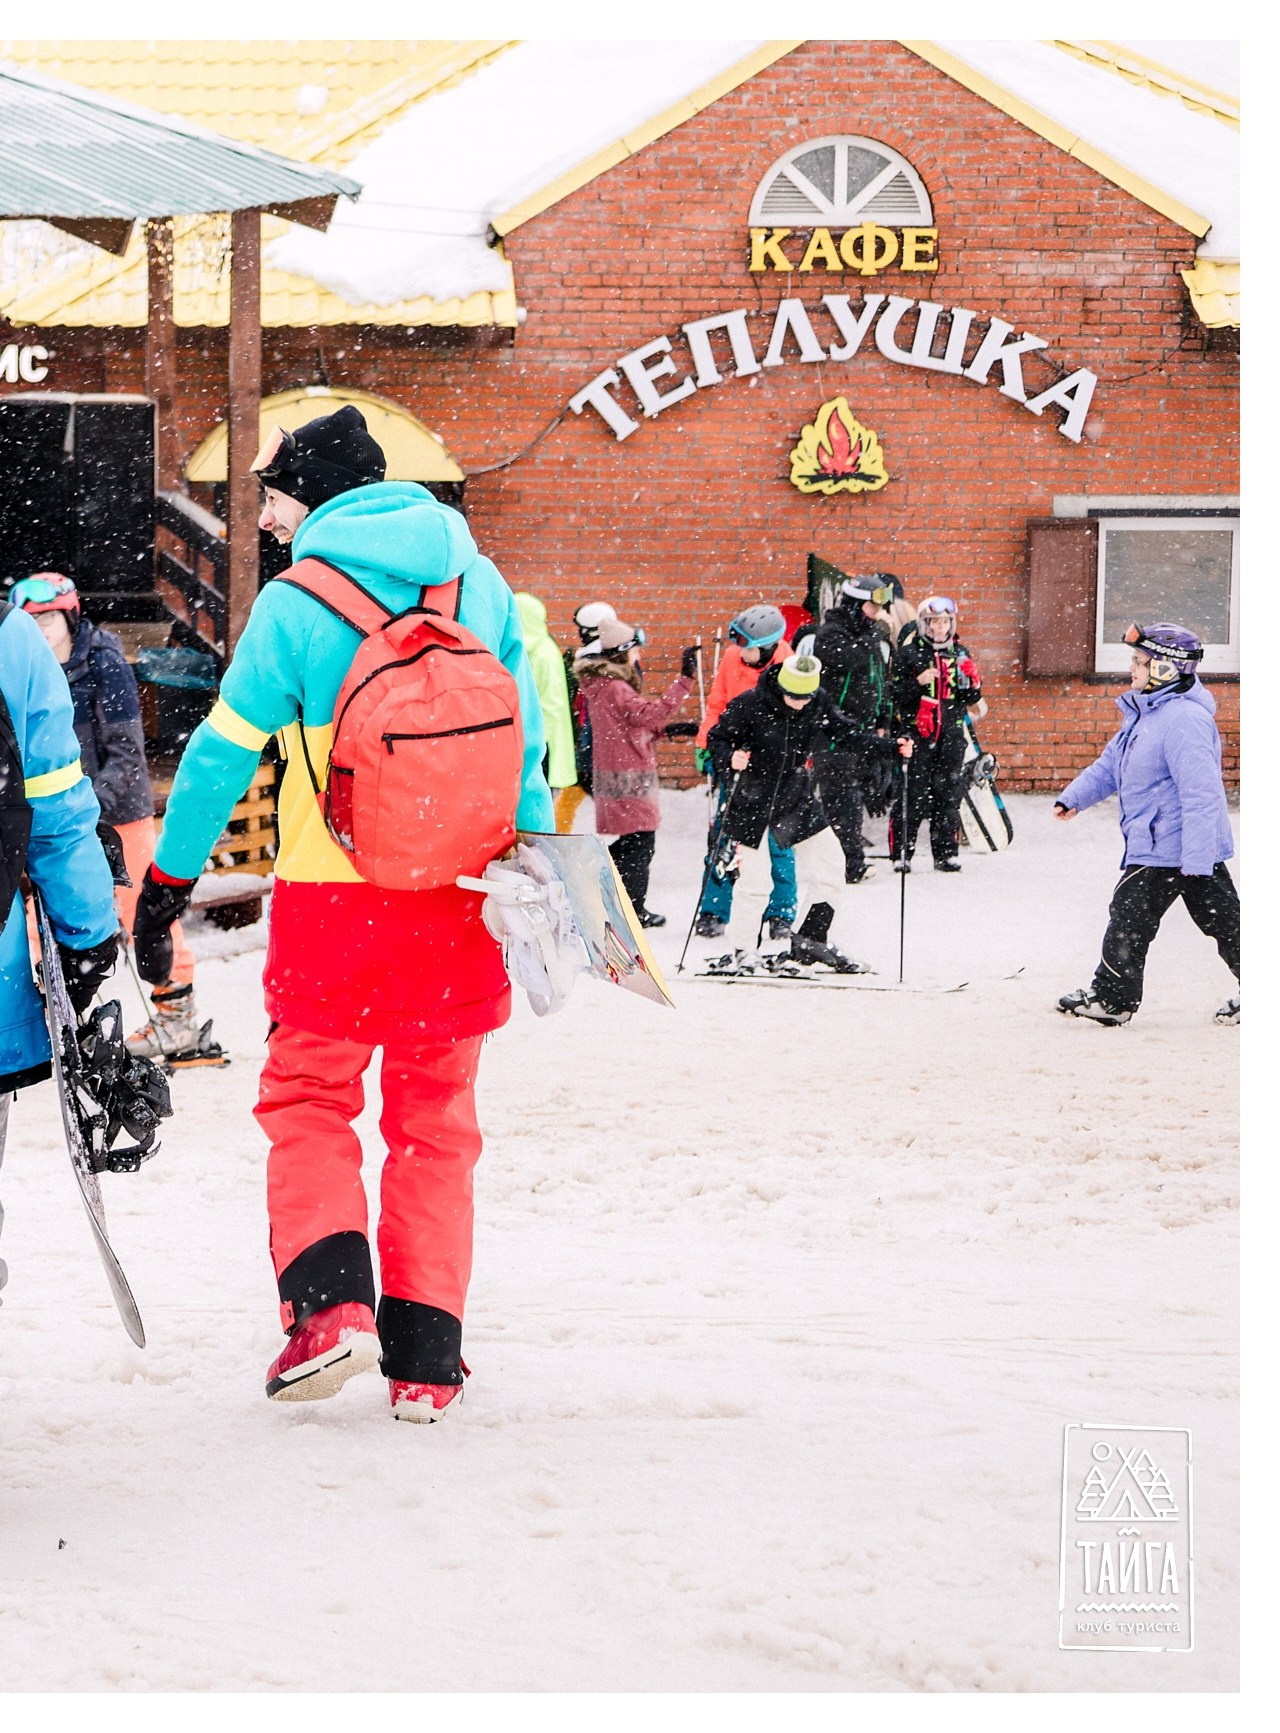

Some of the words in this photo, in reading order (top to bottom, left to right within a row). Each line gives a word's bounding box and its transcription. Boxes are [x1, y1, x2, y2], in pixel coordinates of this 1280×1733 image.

[749, 221, 939, 276] КАФЕ
[568, 293, 1098, 444] ТЕПЛУШКА
[1140, 639, 1189, 658] SWANS
